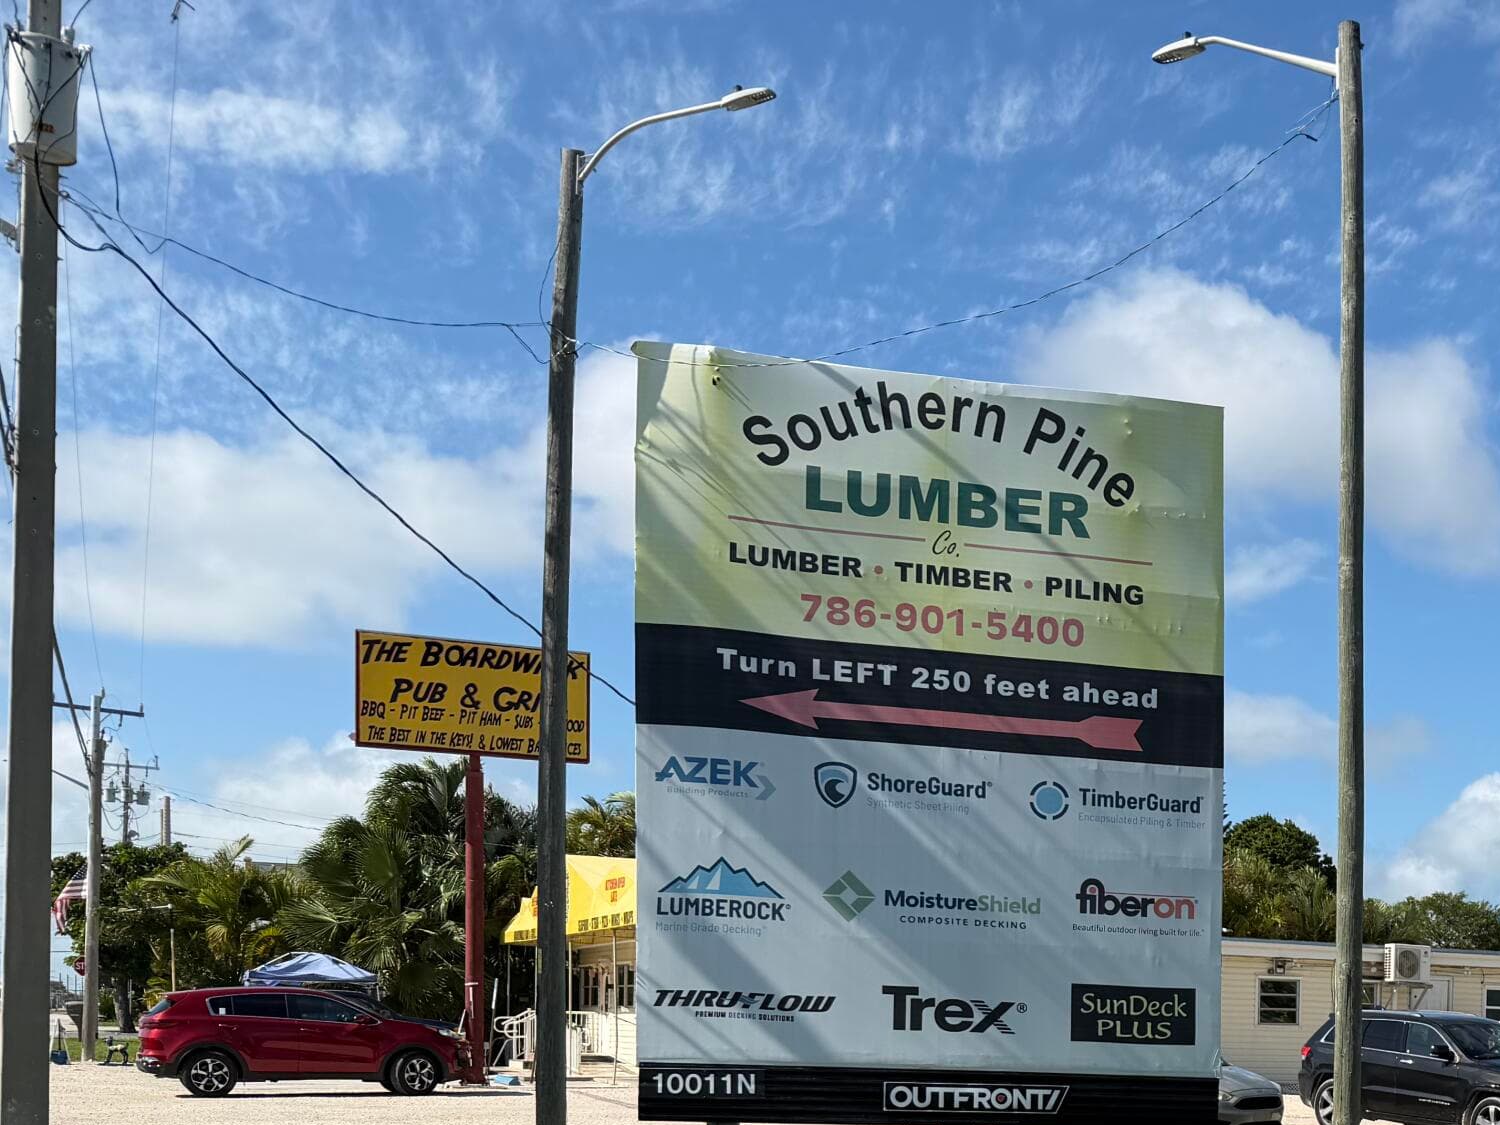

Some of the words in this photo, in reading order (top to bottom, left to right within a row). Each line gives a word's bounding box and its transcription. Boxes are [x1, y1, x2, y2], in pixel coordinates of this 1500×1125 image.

[742, 380, 1007, 467] Southern
[1022, 407, 1135, 507] Pine
[804, 465, 1091, 539] LUMBER
[932, 530, 960, 557] Co.
[729, 541, 863, 578] LUMBER
[894, 561, 1013, 593] TIMBER
[1045, 576, 1144, 606] PILING
[800, 593, 1085, 647] 786-901-5400
[361, 639, 413, 665] THE
[420, 641, 584, 680] BOARDWK
[716, 647, 797, 678] Turn
[812, 658, 898, 686] LEFT
[911, 667, 971, 693] 250
[984, 673, 1050, 700] feet
[1062, 682, 1158, 709] ahead
[390, 678, 448, 704] PUB
[460, 682, 481, 710] &
[360, 699, 386, 720] BBQ
[399, 703, 419, 720] PIT
[421, 705, 446, 722] BEEF
[458, 708, 478, 725] PIT
[479, 710, 502, 727] HAM
[513, 713, 534, 730] SUBS
[367, 725, 386, 741] THE
[389, 726, 412, 743] BEST
[414, 730, 427, 743] IN
[430, 731, 448, 745] THE
[448, 731, 474, 749] KEYS!
[478, 734, 486, 751] &
[489, 735, 525, 752] LOWEST
[655, 755, 760, 788] AZEK
[666, 784, 706, 797] Building
[707, 787, 749, 798] Products
[1078, 787, 1202, 814] TimberGuard
[866, 796, 912, 809] Synthetic
[914, 799, 941, 812] Sheet
[943, 800, 970, 816] Piling
[1078, 813, 1138, 826] Encapsulated
[1139, 817, 1165, 829] Piling
[1174, 819, 1206, 830] Timber
[884, 889, 1041, 915] MoistureShield
[1075, 878, 1196, 920] fiberon
[655, 920, 688, 932] Marine
[690, 922, 719, 933] Grade
[899, 915, 969, 926] COMPOSITE
[974, 919, 1027, 930] DECKING
[1072, 923, 1106, 933] Beautiful
[1107, 925, 1137, 934] outdoor
[1138, 927, 1159, 937] living
[1160, 928, 1177, 937] built
[1177, 928, 1187, 937] for
[695, 1010, 727, 1018] PREMIUM
[728, 1012, 757, 1020] DECKING
[758, 1014, 795, 1022] SOLUTIONS
[1080, 992, 1188, 1018] SunDeck
[1096, 1019, 1172, 1040] PLUS
[652, 1073, 756, 1095] 10011N
